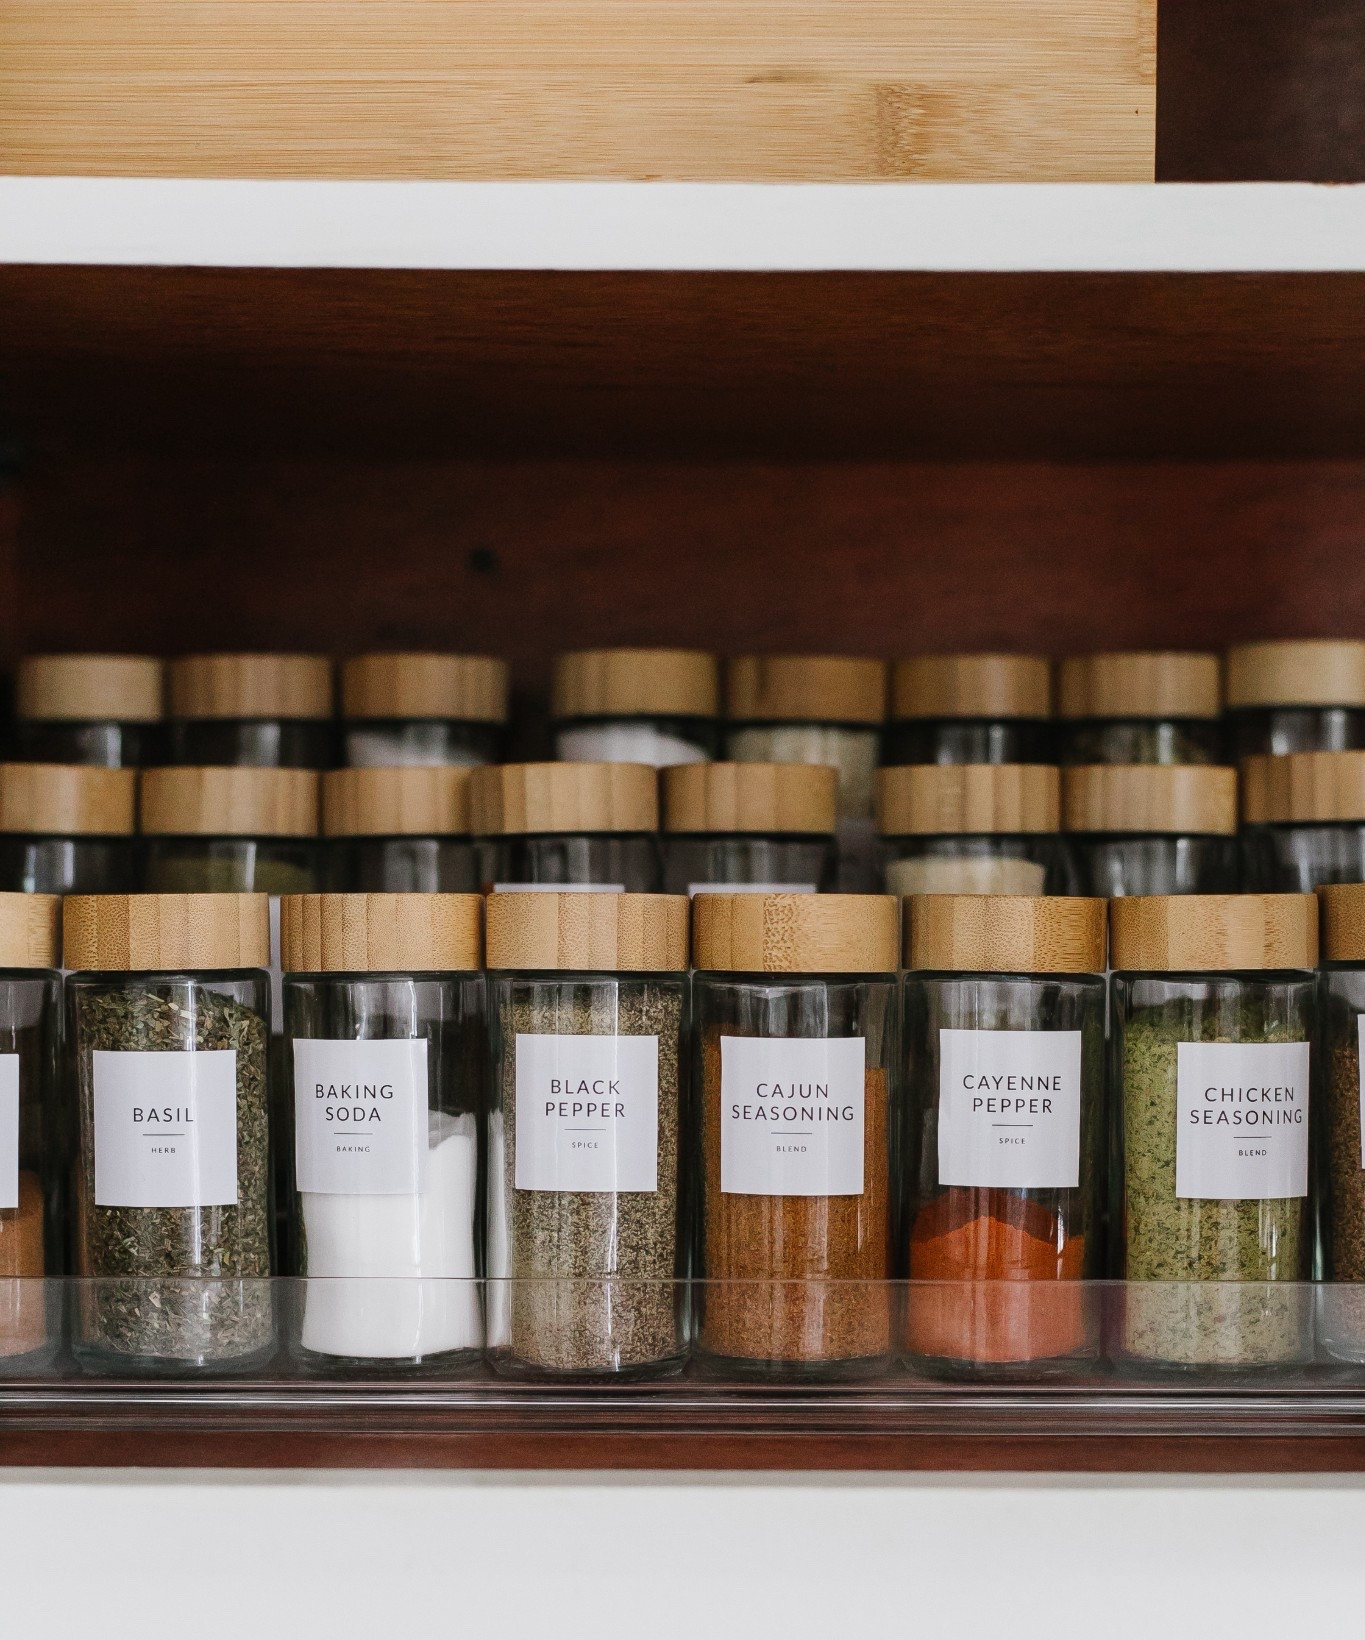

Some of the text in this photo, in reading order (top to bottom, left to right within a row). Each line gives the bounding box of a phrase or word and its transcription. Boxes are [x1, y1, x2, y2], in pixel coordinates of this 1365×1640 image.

[550, 1078, 620, 1095] BLACK
[756, 1082, 828, 1099] CAJUN
[962, 1074, 1062, 1091] CAYENNE
[315, 1083, 394, 1100] BAKING
[1204, 1086, 1294, 1103] CHICKEN
[325, 1106, 382, 1122] SODA
[545, 1101, 626, 1118] PEPPER
[731, 1104, 854, 1122] SEASONING
[972, 1097, 1053, 1114] PEPPER
[133, 1107, 194, 1123] BASIL
[1189, 1108, 1302, 1126] SEASONING
[336, 1145, 370, 1153] BAKING
[571, 1141, 599, 1149] SPICE
[776, 1145, 807, 1153] BLEND
[999, 1137, 1026, 1145] SPICE
[1238, 1149, 1267, 1157] BLEND
